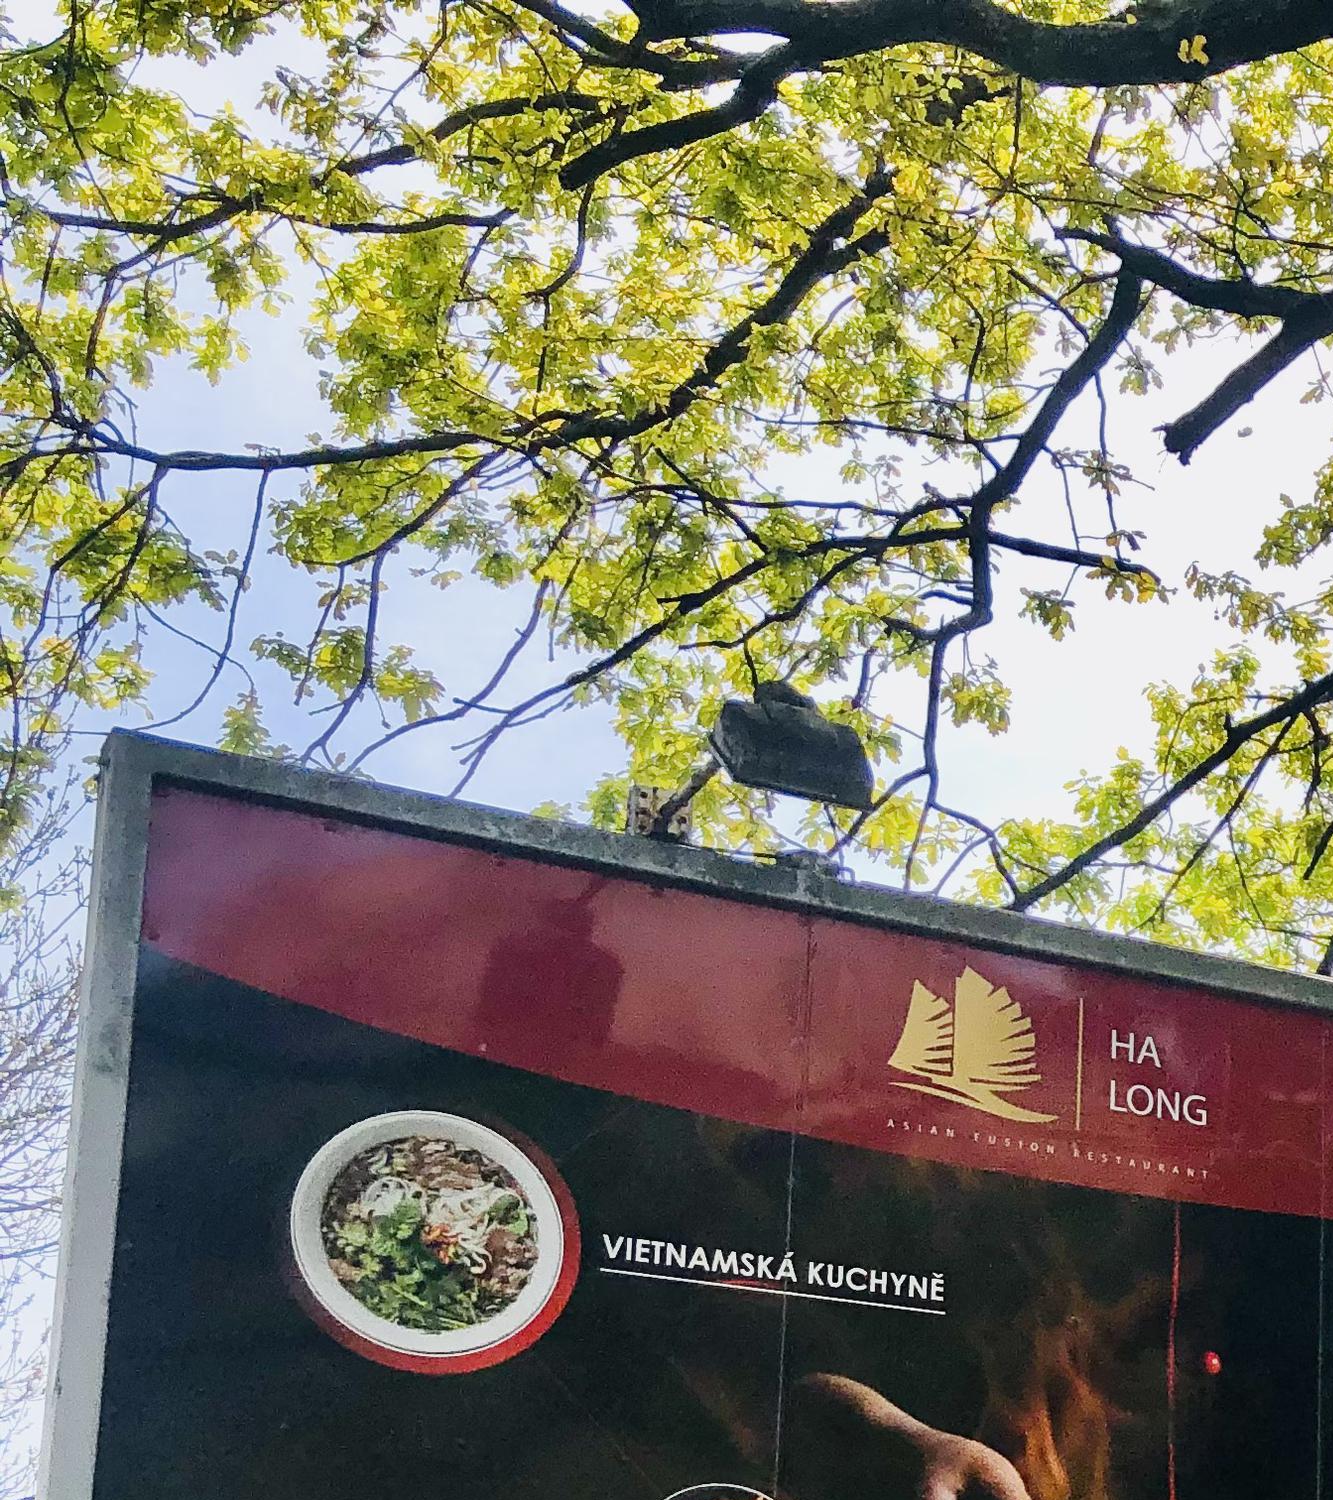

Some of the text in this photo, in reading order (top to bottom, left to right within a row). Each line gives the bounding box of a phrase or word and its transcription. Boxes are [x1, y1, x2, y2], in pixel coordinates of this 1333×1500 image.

[1111, 1029, 1162, 1068] HA
[1109, 1079, 1207, 1126] LONG
[886, 1117, 1209, 1180] ASIAN FUSION RESTAURANT
[602, 1233, 945, 1302] VIETNAMSKÁ KUCHYNĚ
